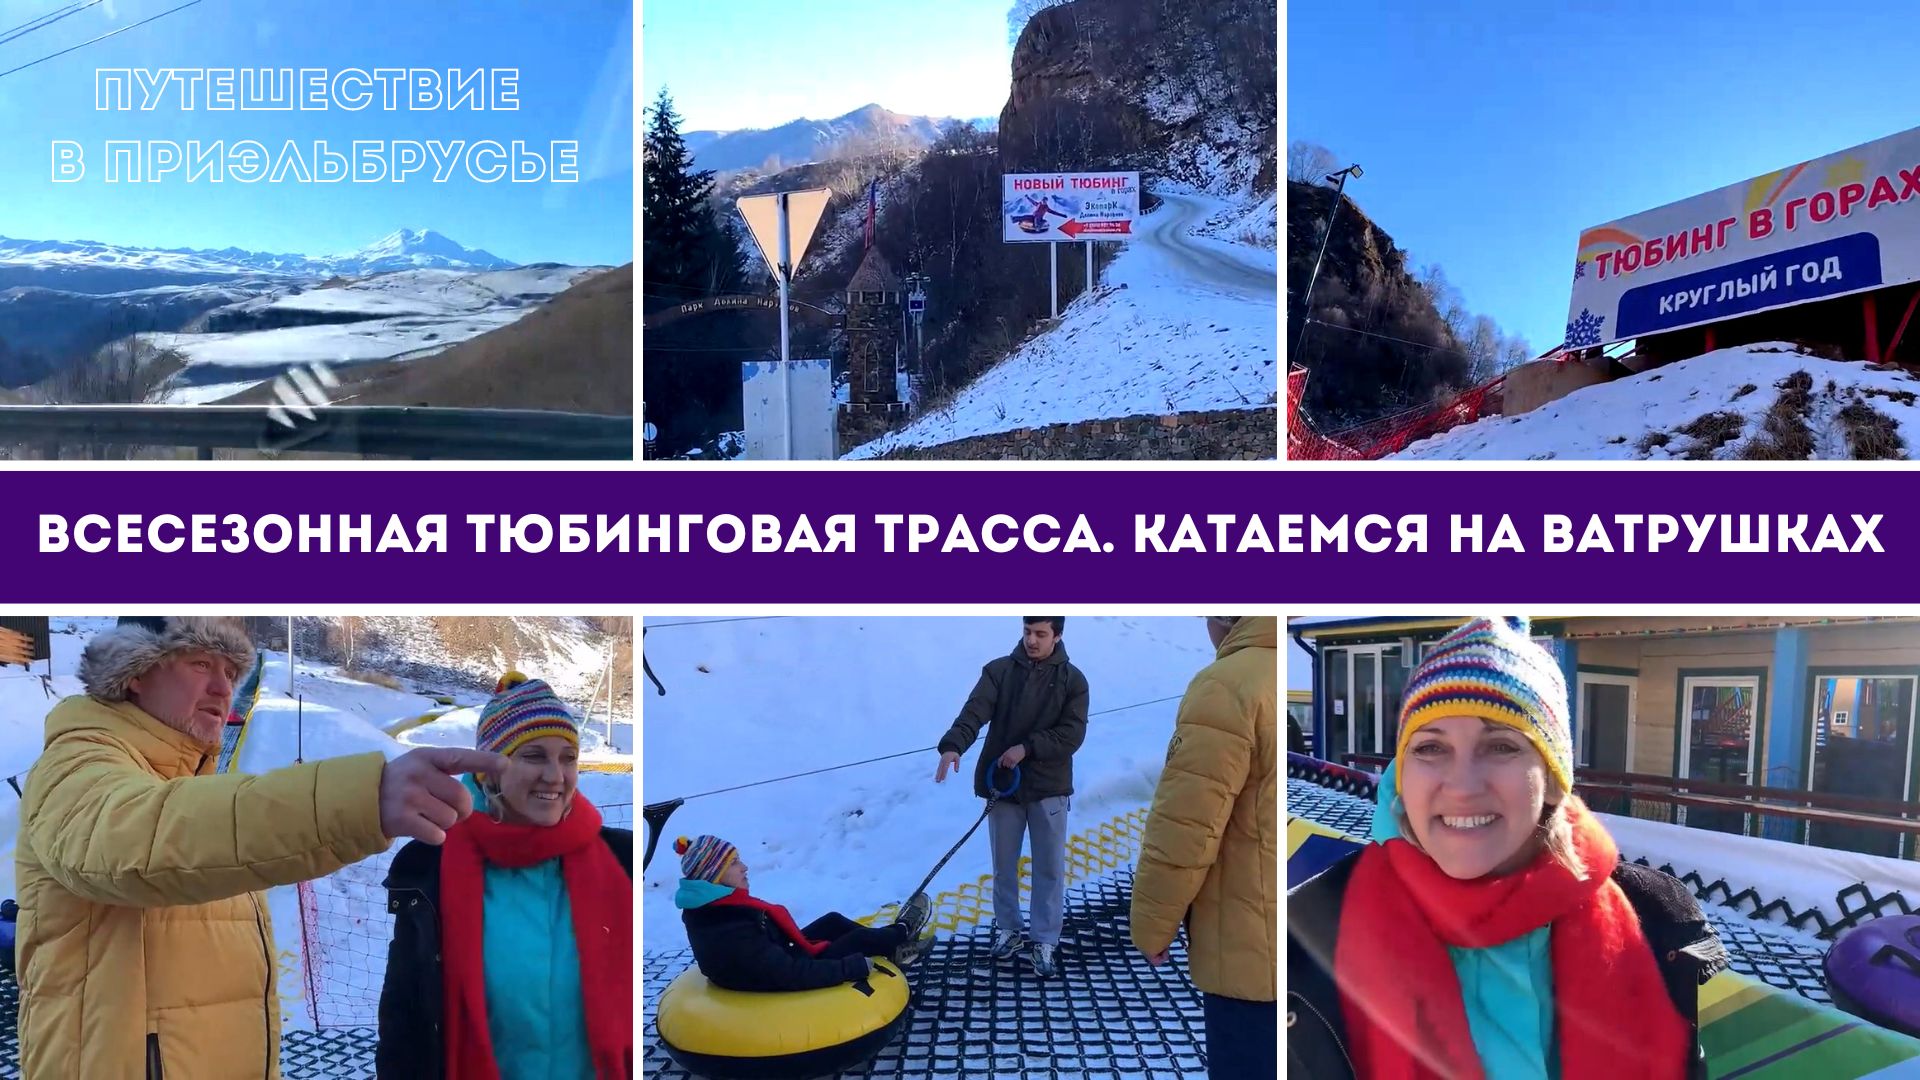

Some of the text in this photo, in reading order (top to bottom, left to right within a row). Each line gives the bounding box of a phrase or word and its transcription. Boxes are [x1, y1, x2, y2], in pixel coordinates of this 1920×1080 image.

[1014, 176, 1129, 190] НОВЫЙ ТЮБИНГ
[1595, 163, 1920, 280] ТЮБИНГ В ГОРАХ
[1659, 256, 1843, 315] КРУГЛЫЙ ГОД
[681, 302, 703, 313] Парк
